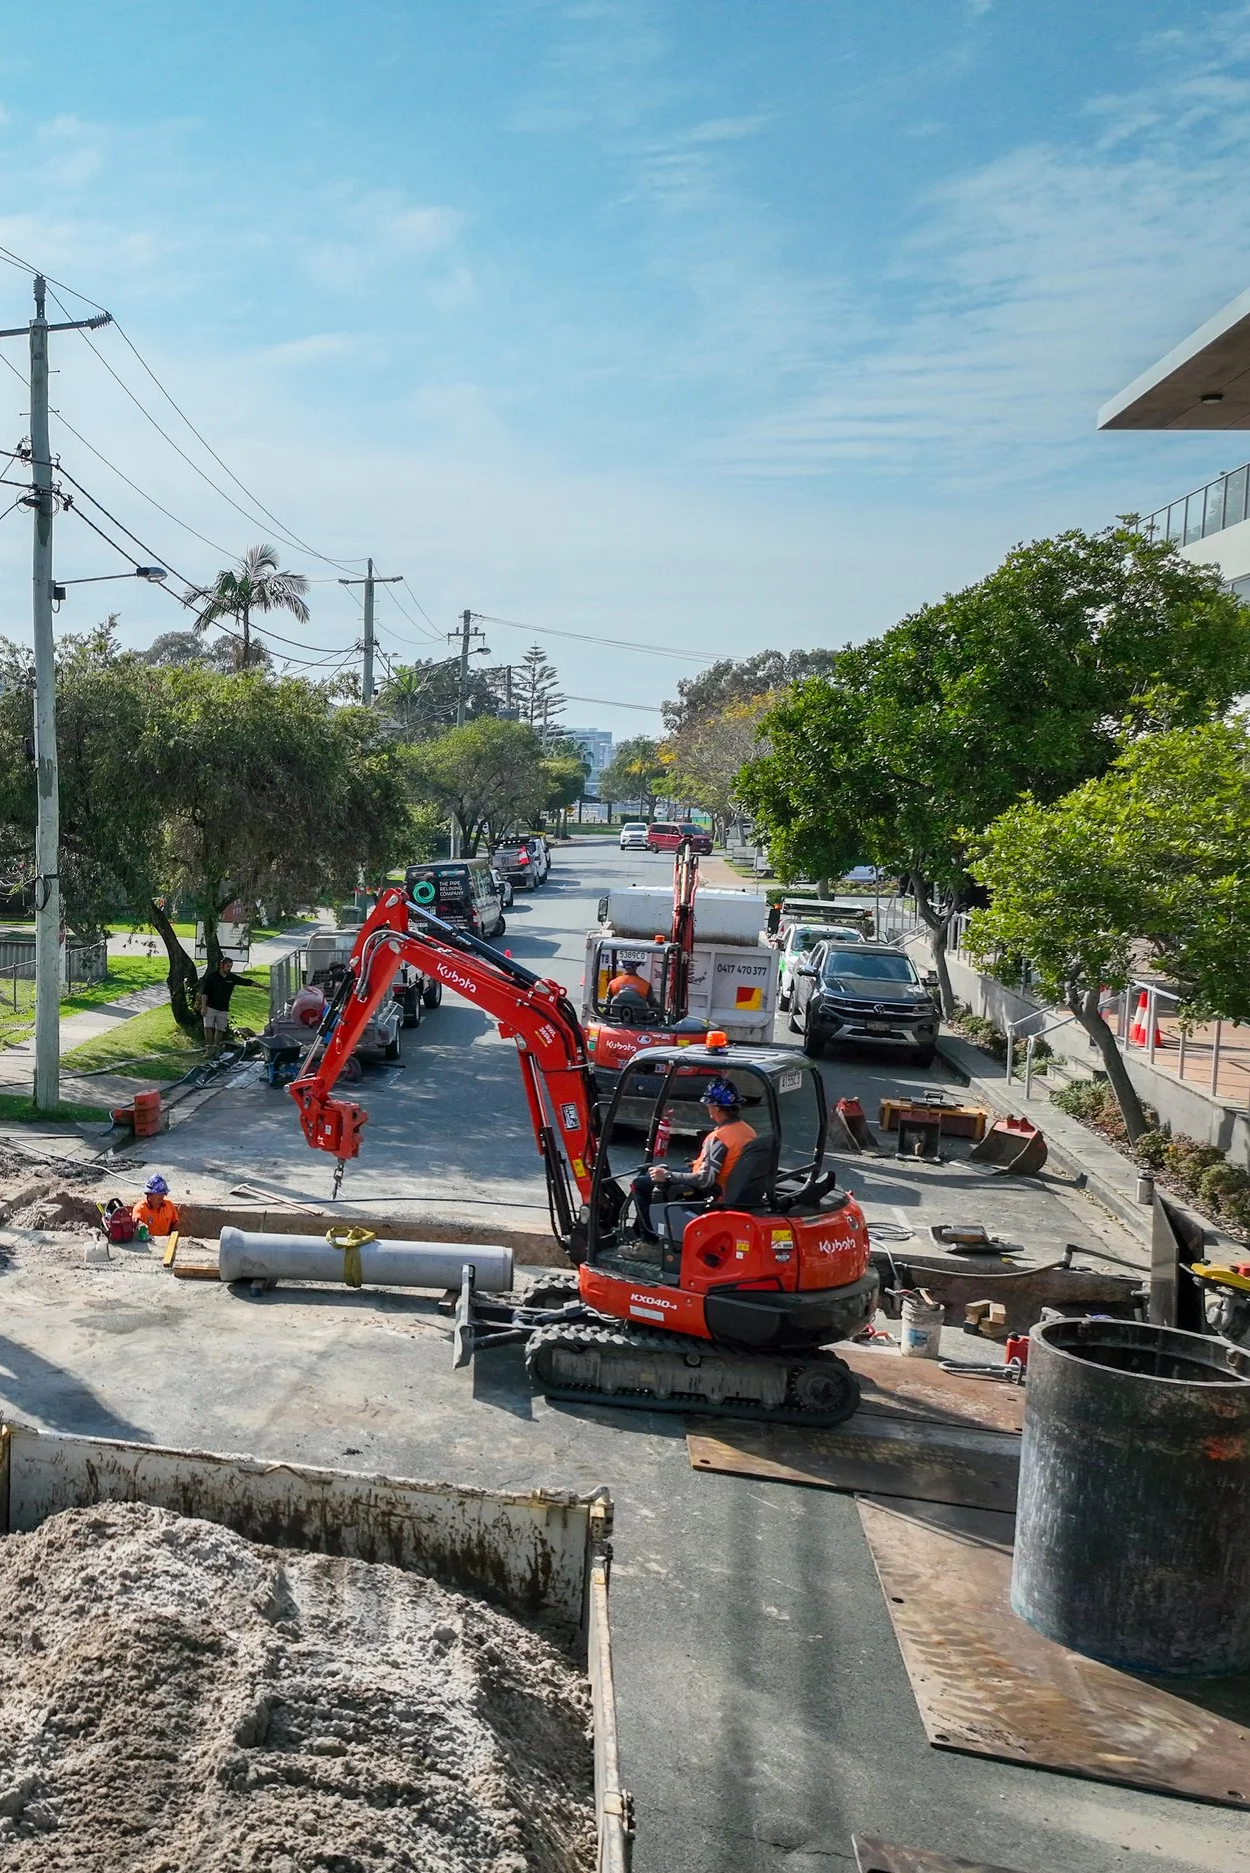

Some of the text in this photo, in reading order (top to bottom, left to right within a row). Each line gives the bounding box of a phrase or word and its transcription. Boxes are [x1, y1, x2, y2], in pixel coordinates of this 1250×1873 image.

[717, 963, 767, 976] 0417 470 377
[436, 962, 478, 994] Kubota
[606, 1040, 637, 1052] Kubota
[819, 1236, 856, 1254] Kubota
